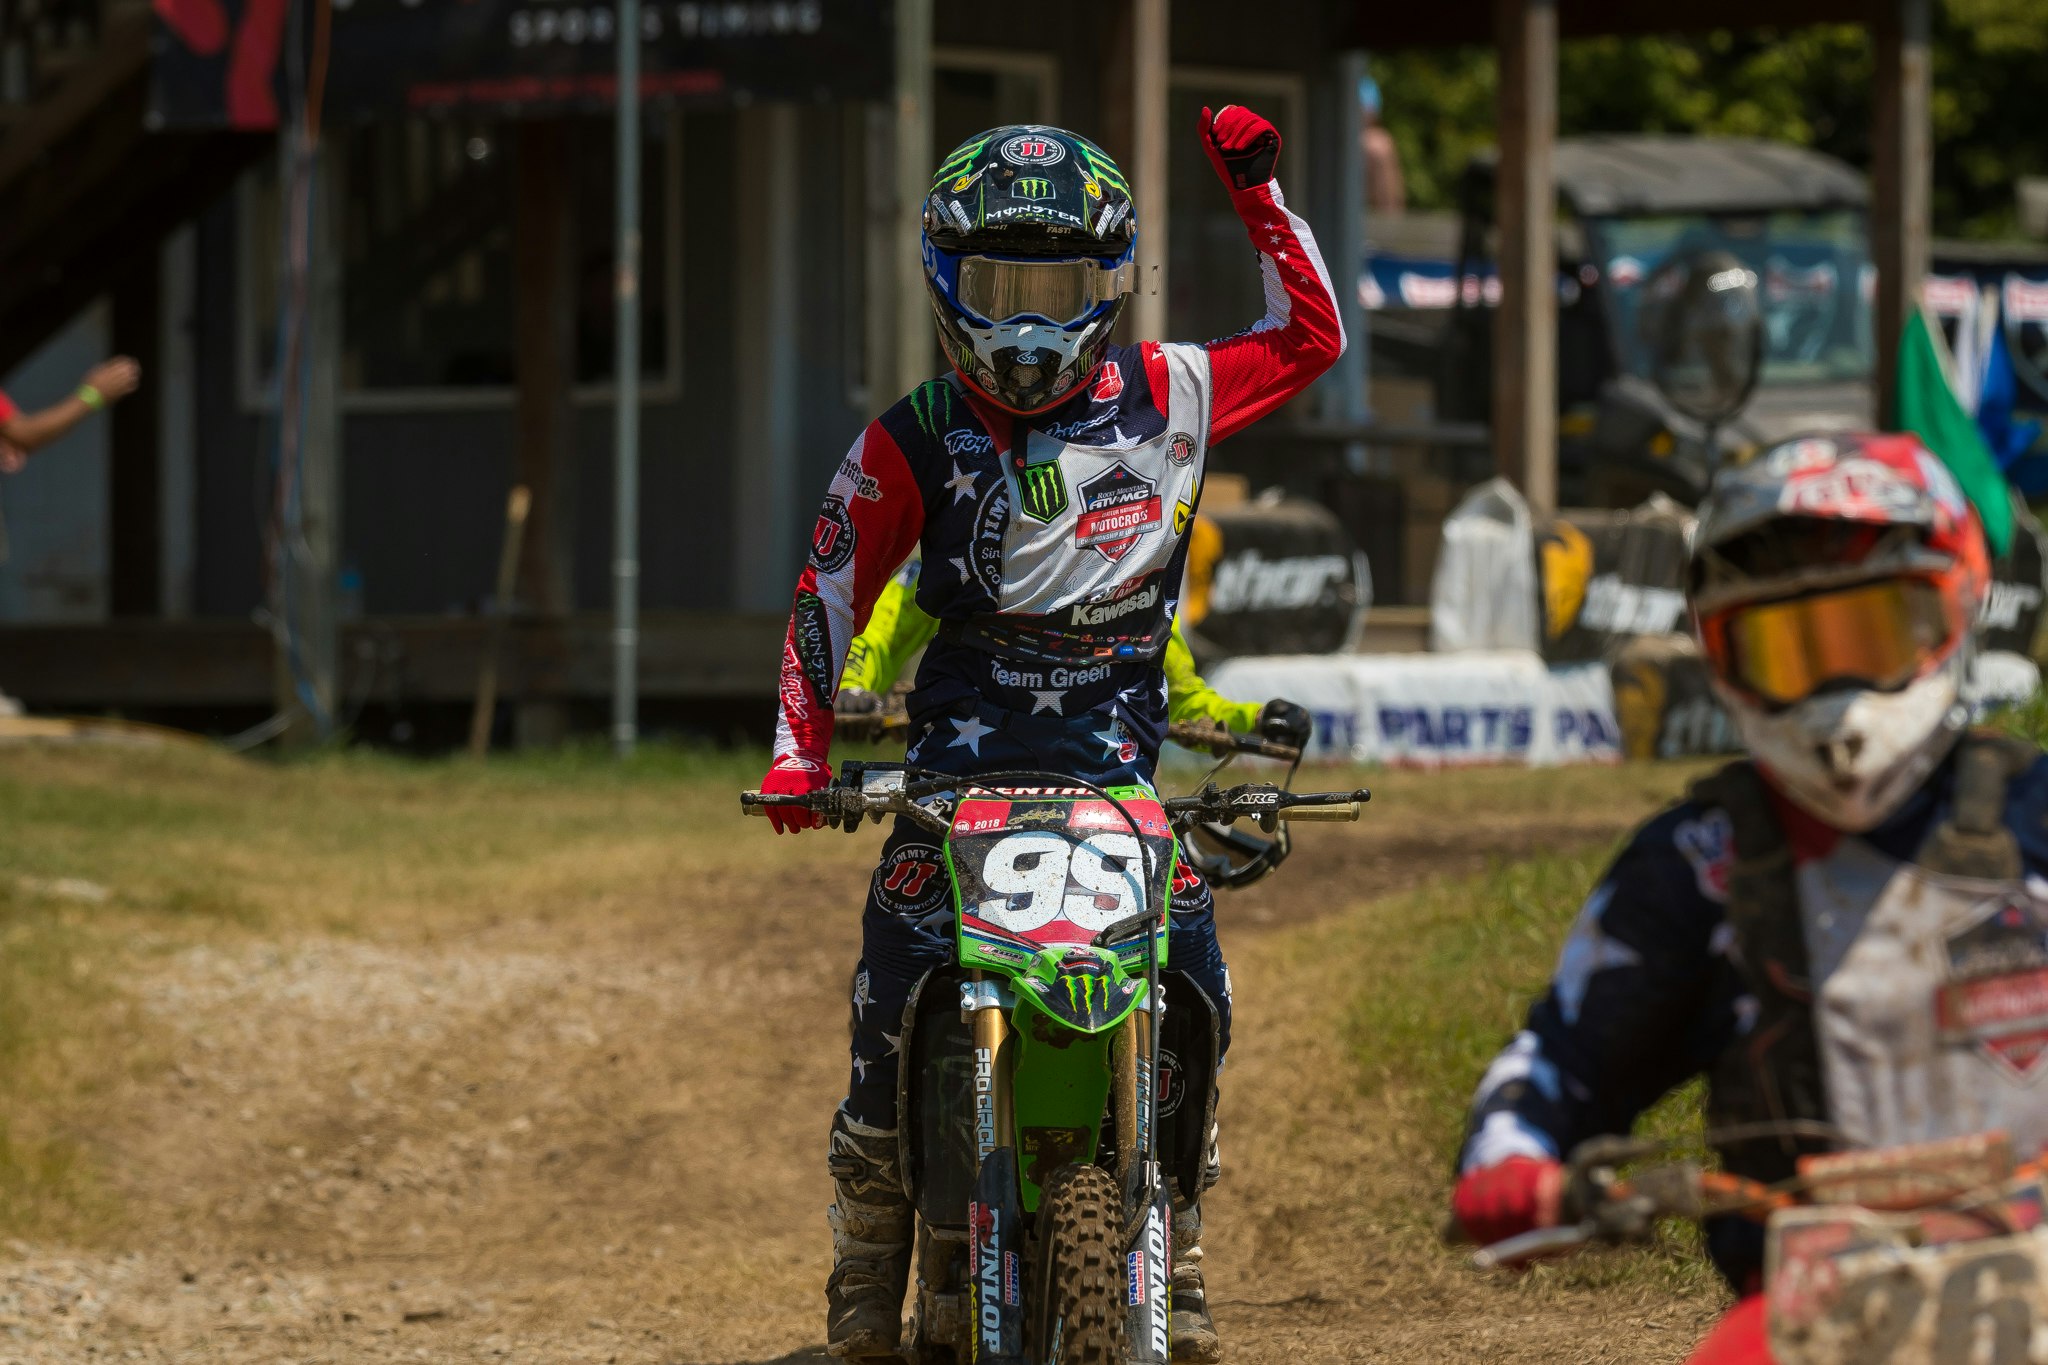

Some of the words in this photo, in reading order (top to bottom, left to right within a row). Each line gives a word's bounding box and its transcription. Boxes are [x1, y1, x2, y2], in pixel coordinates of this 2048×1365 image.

[508, 9, 663, 47] SPORS
[986, 205, 1082, 225] MONSTER
[1046, 226, 1072, 234] FAST!
[1071, 582, 1160, 626] Kawasak
[990, 659, 1043, 688] Team
[1050, 662, 1111, 688] Green
[967, 786, 1108, 796] RENTHA
[1231, 793, 1279, 805] ARC
[973, 818, 1001, 831] 2018
[891, 849, 929, 866] IMMY
[978, 830, 1157, 933] 99
[974, 1047, 993, 1092] PRO
[975, 1093, 996, 1161] CIRCU
[1128, 1252, 1137, 1305] PARTS
[1137, 1251, 1145, 1304] UNLIMITED
[1148, 1205, 1168, 1360] DUNLOP
